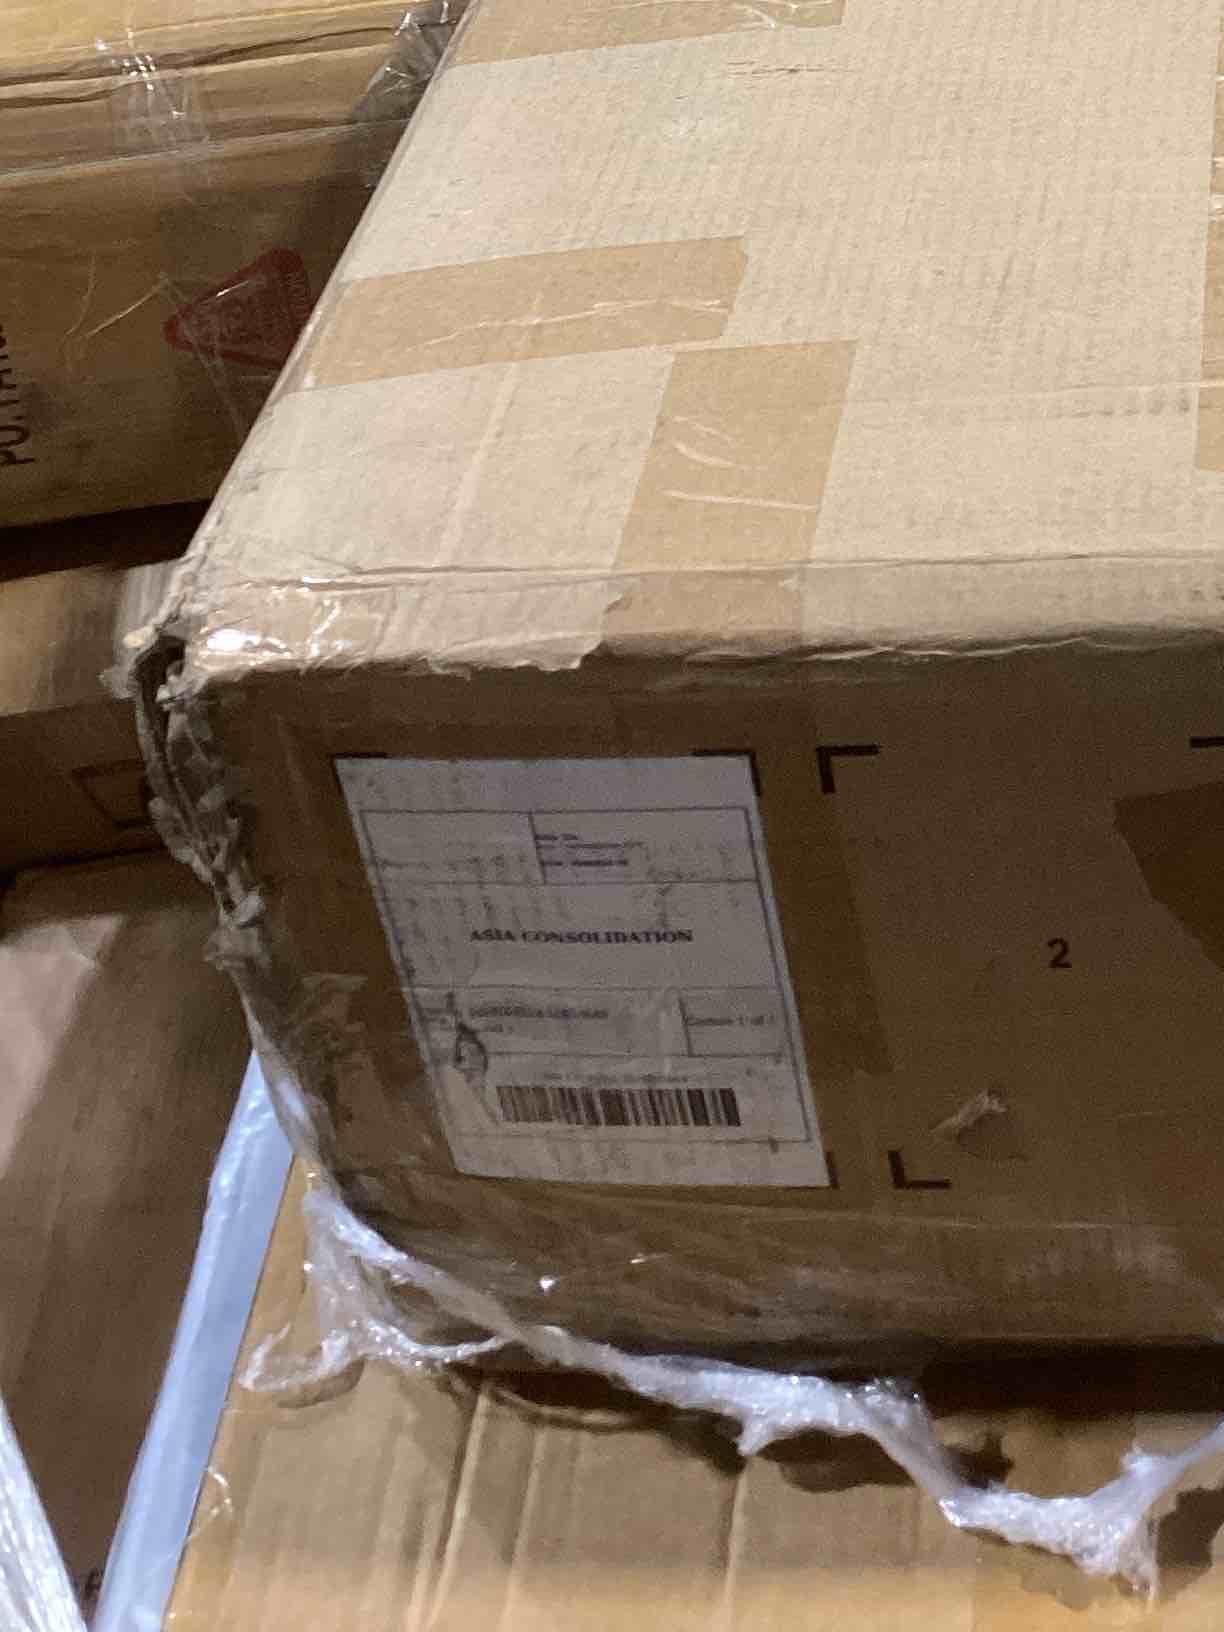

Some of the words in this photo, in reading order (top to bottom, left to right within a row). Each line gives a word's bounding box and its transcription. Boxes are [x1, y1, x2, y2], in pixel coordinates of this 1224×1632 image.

[469, 928, 517, 943] ASIA
[520, 928, 694, 945] CONSOLIDATION
[1047, 937, 1073, 970] 2
